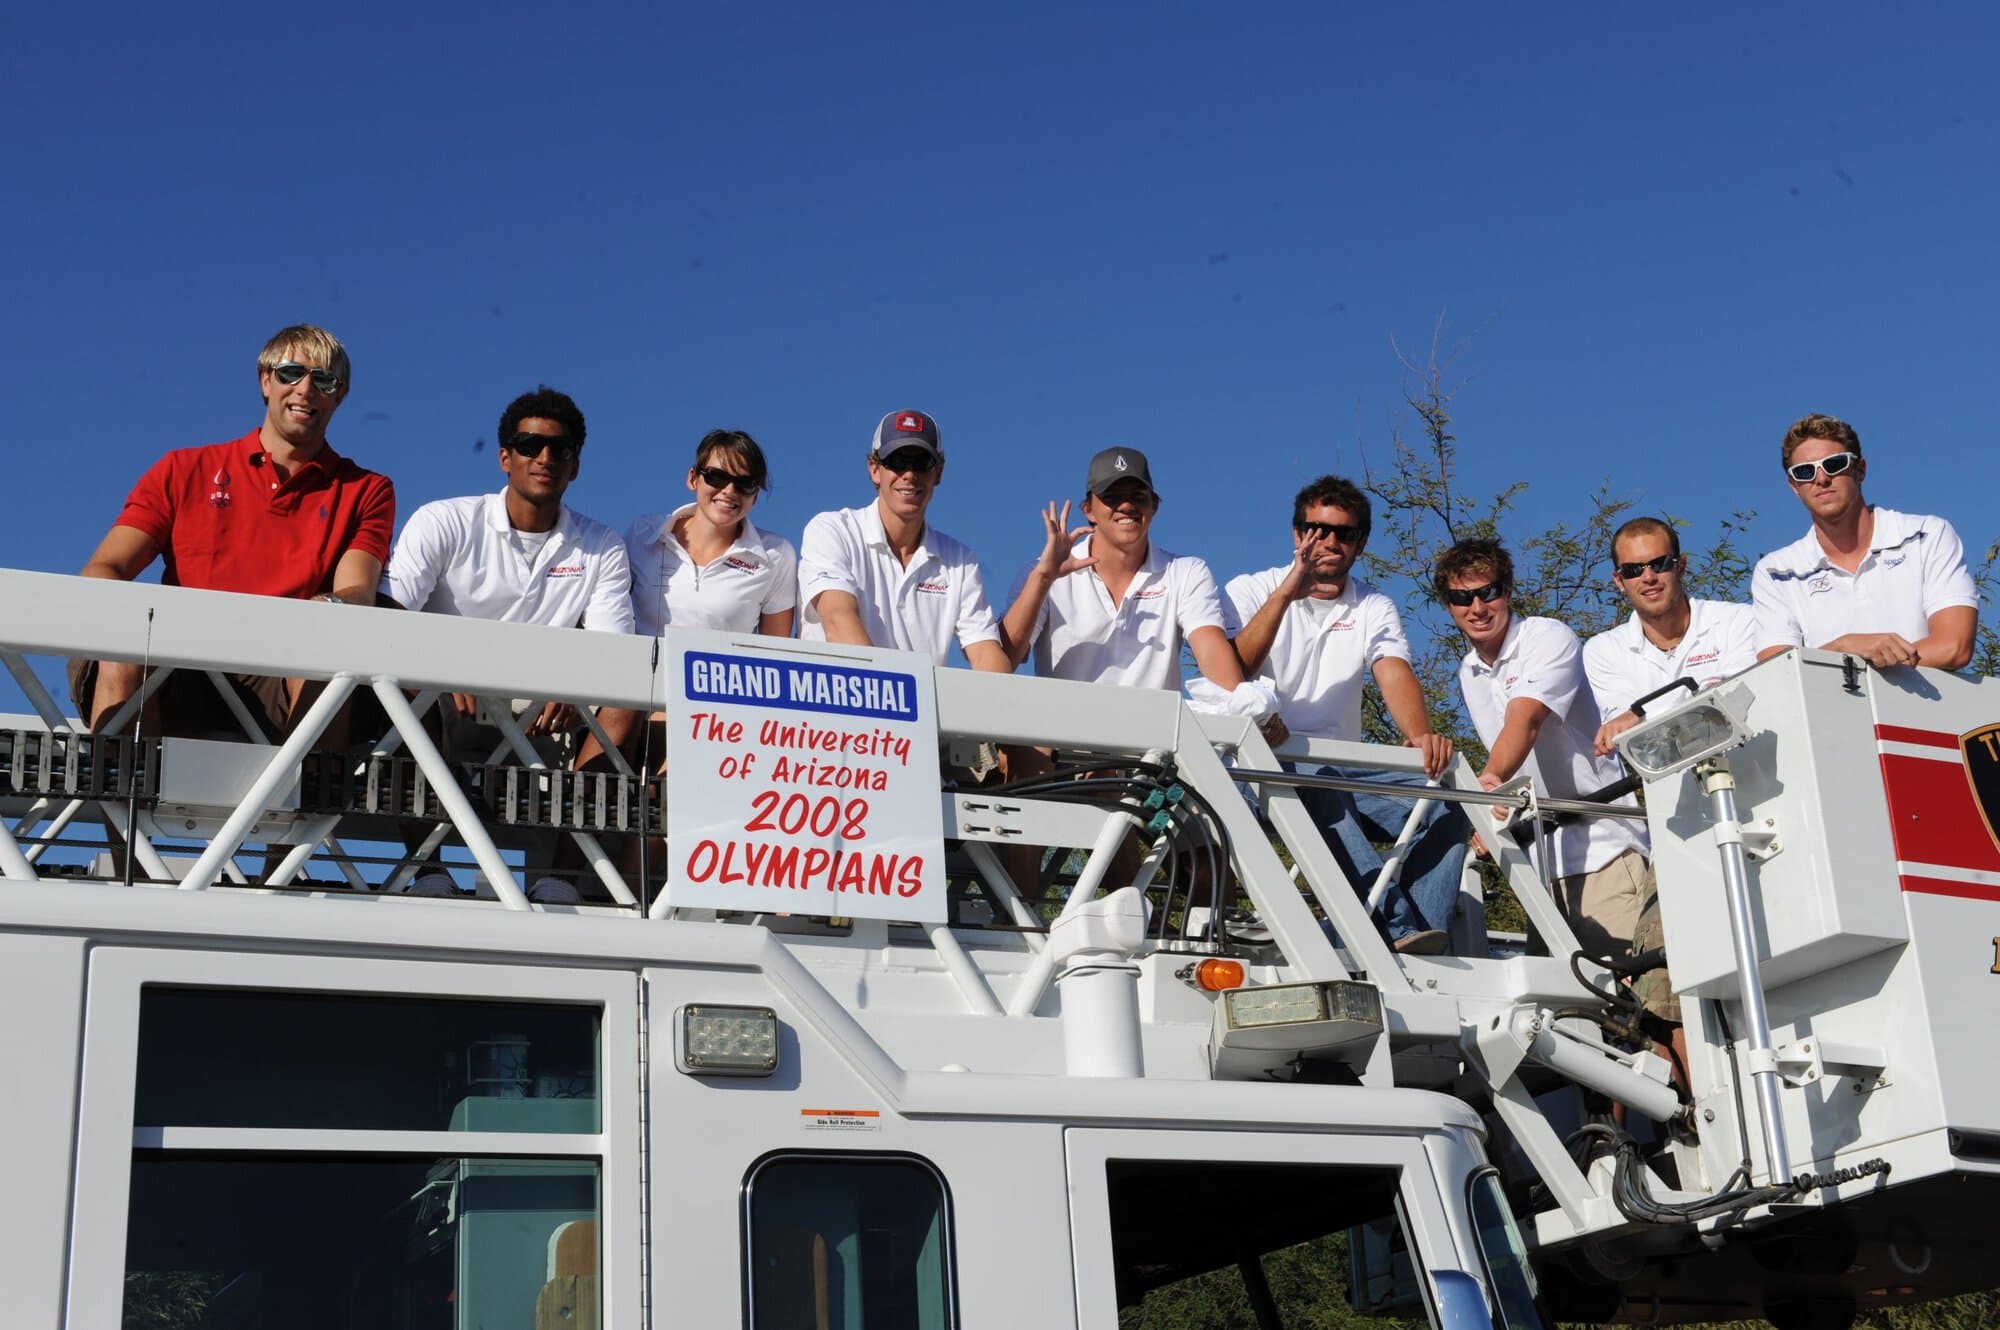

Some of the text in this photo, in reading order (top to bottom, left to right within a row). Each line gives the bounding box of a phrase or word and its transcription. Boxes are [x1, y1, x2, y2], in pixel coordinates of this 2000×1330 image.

[210, 491, 230, 501] USA
[916, 582, 945, 591] ARIZONA
[1686, 652, 1718, 663] ARIZONA
[692, 659, 911, 713] GRAND MARSHAL
[690, 713, 911, 766] The University
[719, 753, 888, 791] of Arizona
[744, 790, 869, 840] 2008
[686, 839, 924, 897] OLYMPIANS
